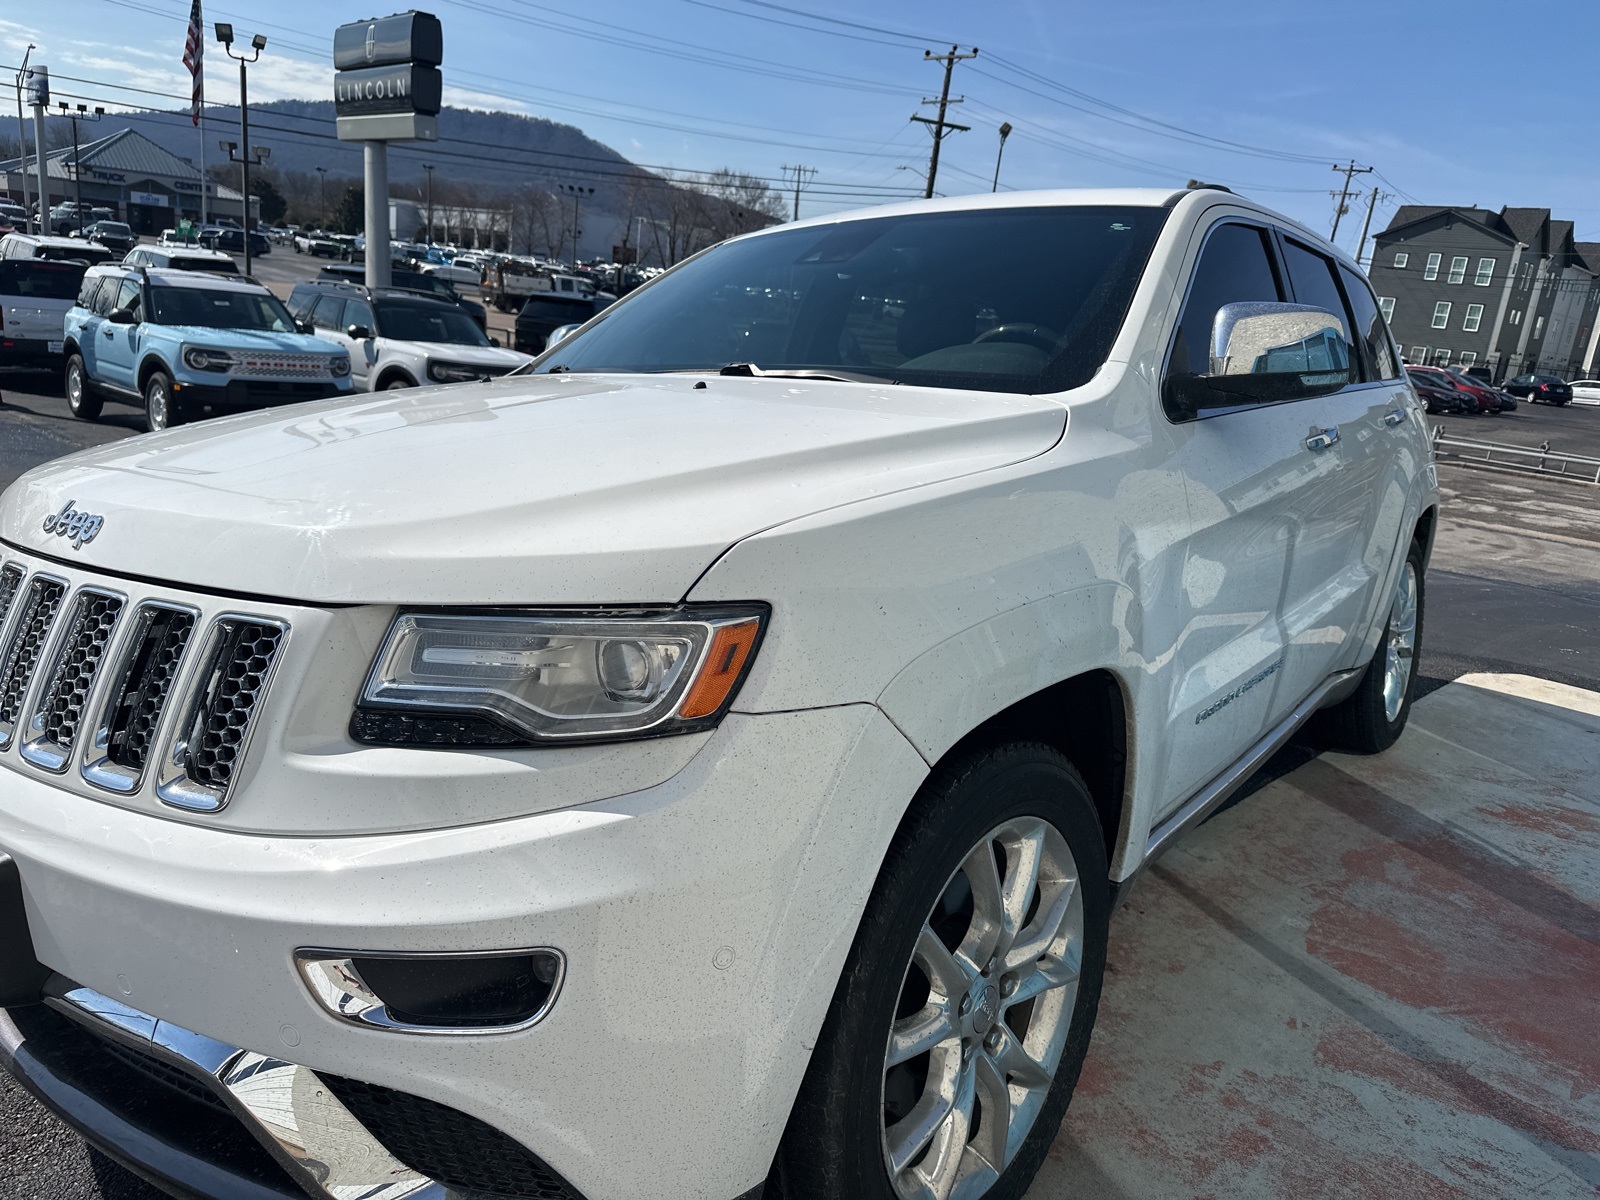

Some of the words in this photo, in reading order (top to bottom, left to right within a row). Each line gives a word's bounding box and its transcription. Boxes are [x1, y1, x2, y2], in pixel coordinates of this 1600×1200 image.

[338, 78, 406, 102] LINCOLN
[92, 171, 126, 183] TRUCK
[43, 499, 105, 551] Jeep
